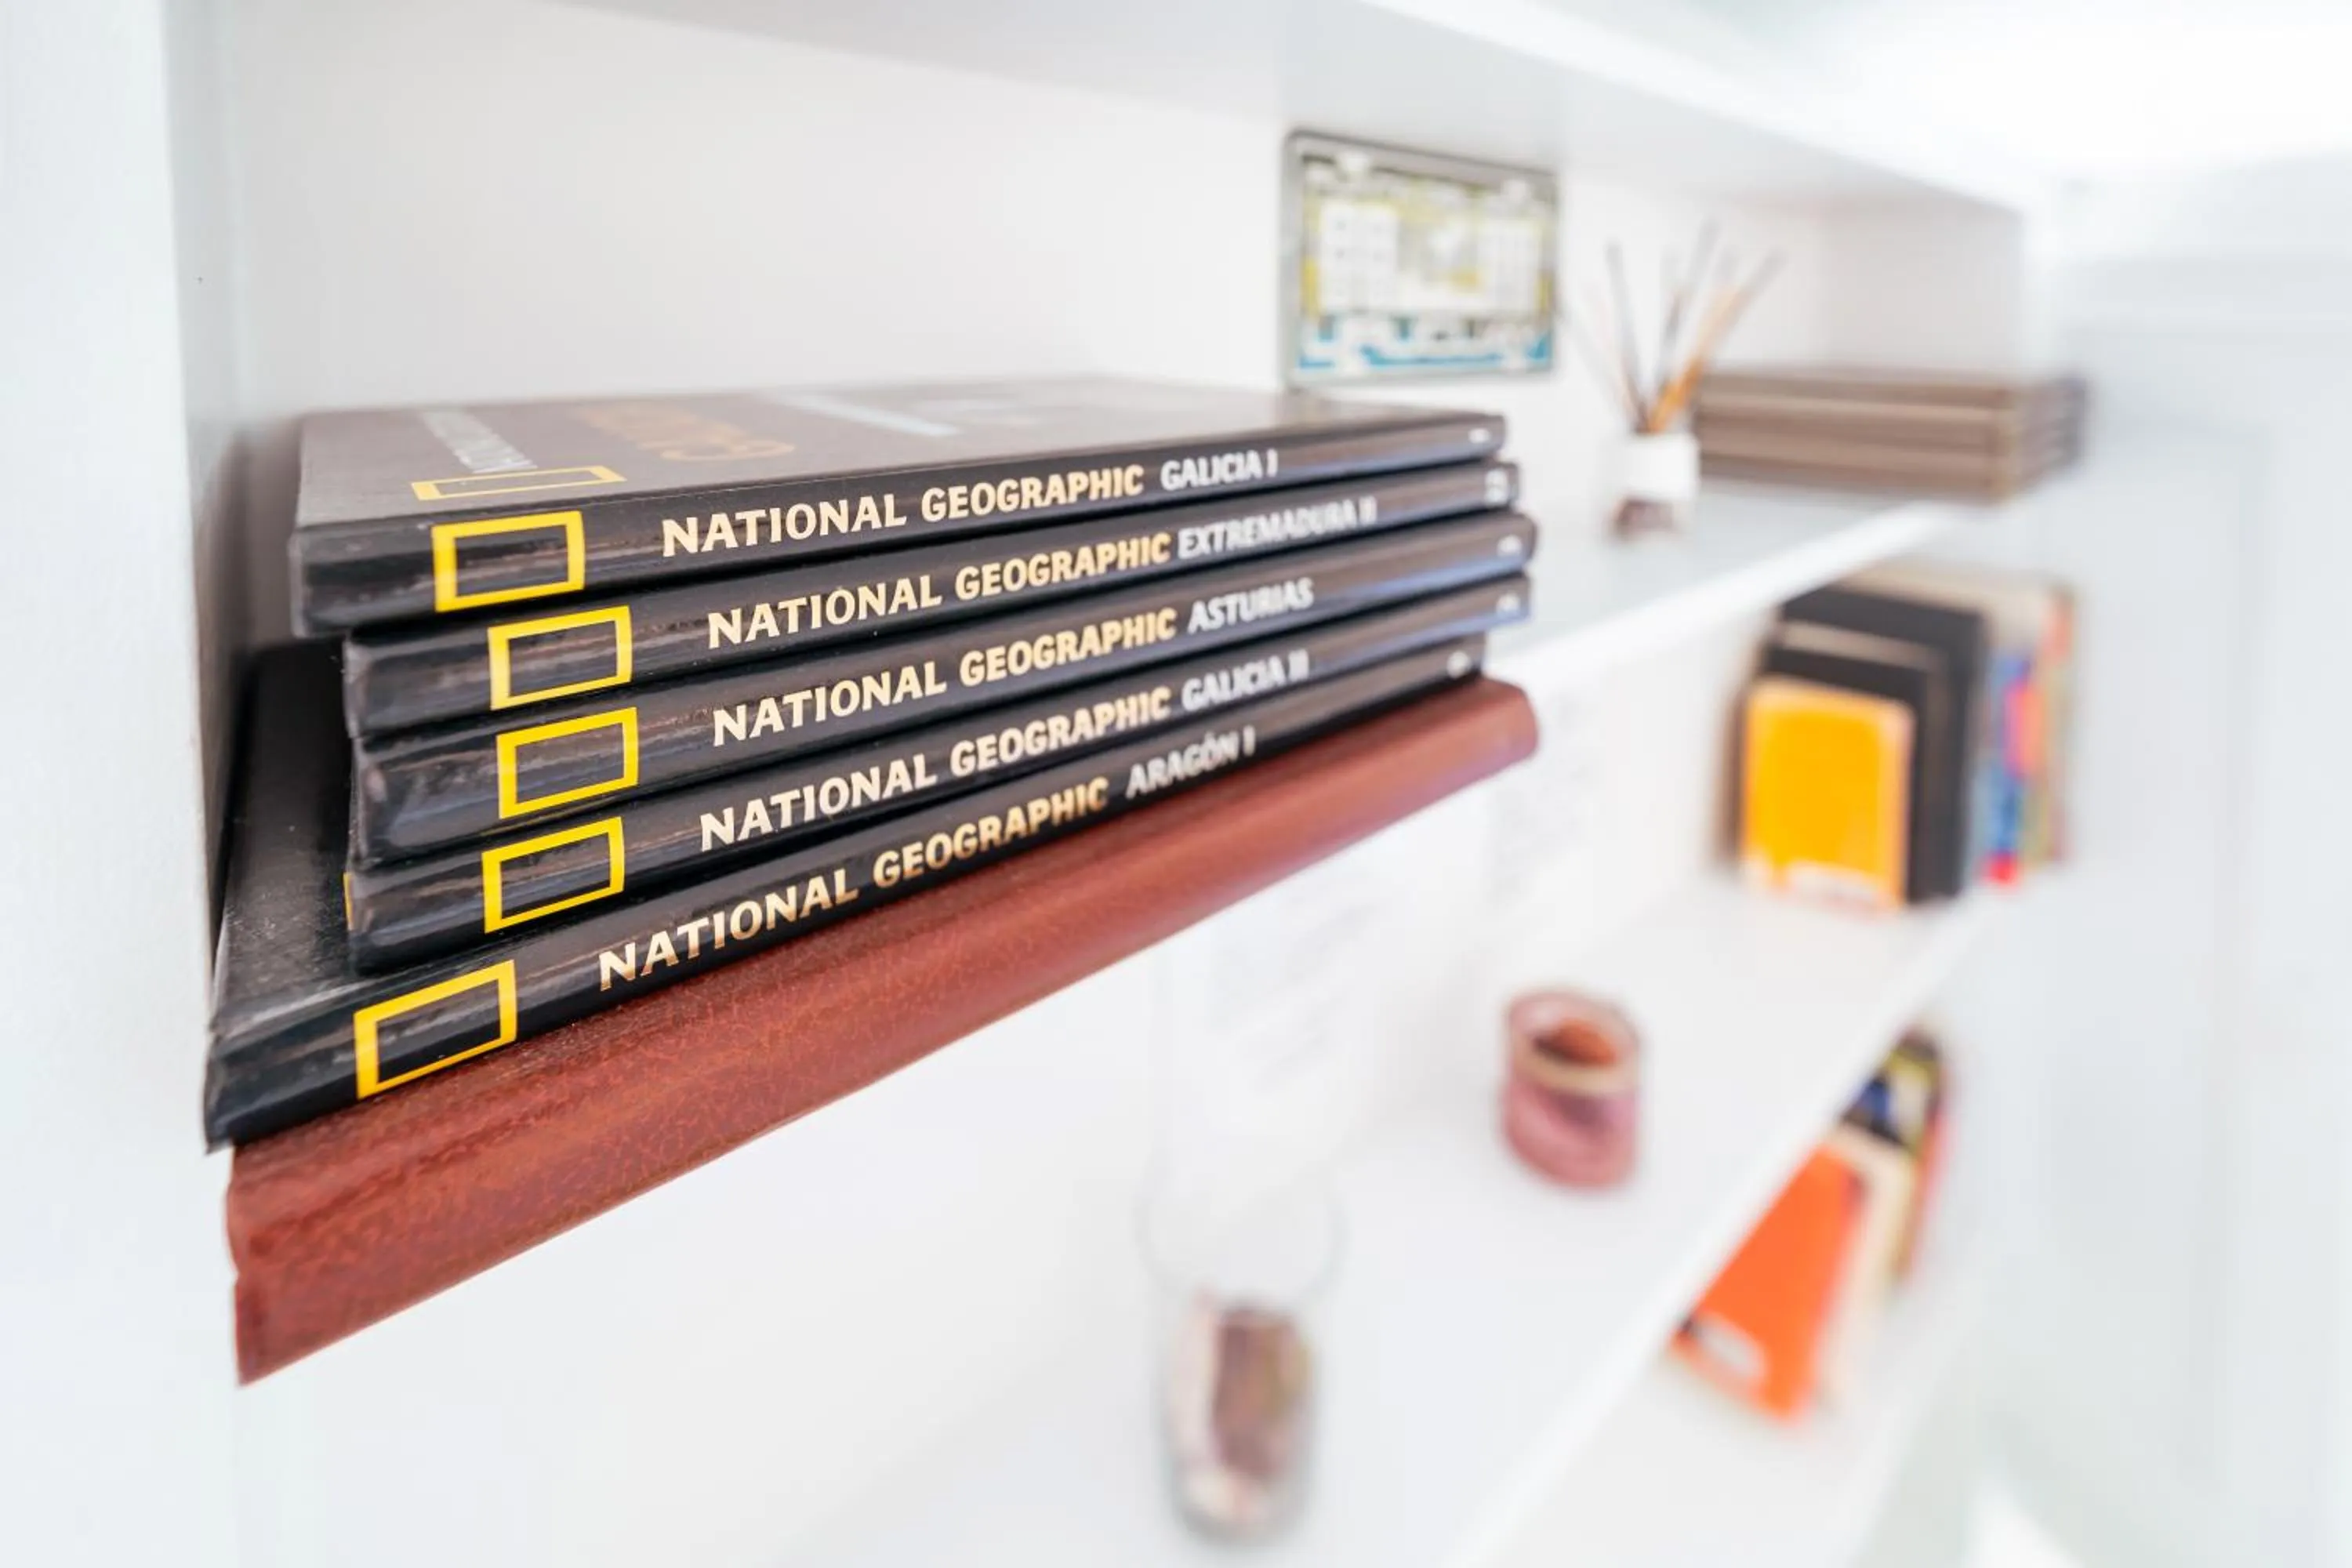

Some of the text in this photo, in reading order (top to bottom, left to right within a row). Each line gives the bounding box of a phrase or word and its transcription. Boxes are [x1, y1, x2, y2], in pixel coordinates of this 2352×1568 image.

[662, 448, 1279, 557] NATIONAL GEOGRAPHIC GALICIA I
[707, 575, 942, 649] NATIONAL
[955, 532, 1171, 601] GEOGRAPHIC
[1178, 501, 1356, 560] EXTREMADURA
[713, 577, 1314, 746] NATIONAL GEOGRAPHIC ASTURIAS
[699, 753, 938, 852] NATIONAL
[950, 687, 1171, 778] GEOGRAPHIC
[1181, 654, 1285, 711] GALICIA
[598, 869, 858, 992] NATIONAL
[873, 777, 1109, 887] GEOGRAPHIC
[1125, 731, 1241, 800] ARAGÓN
